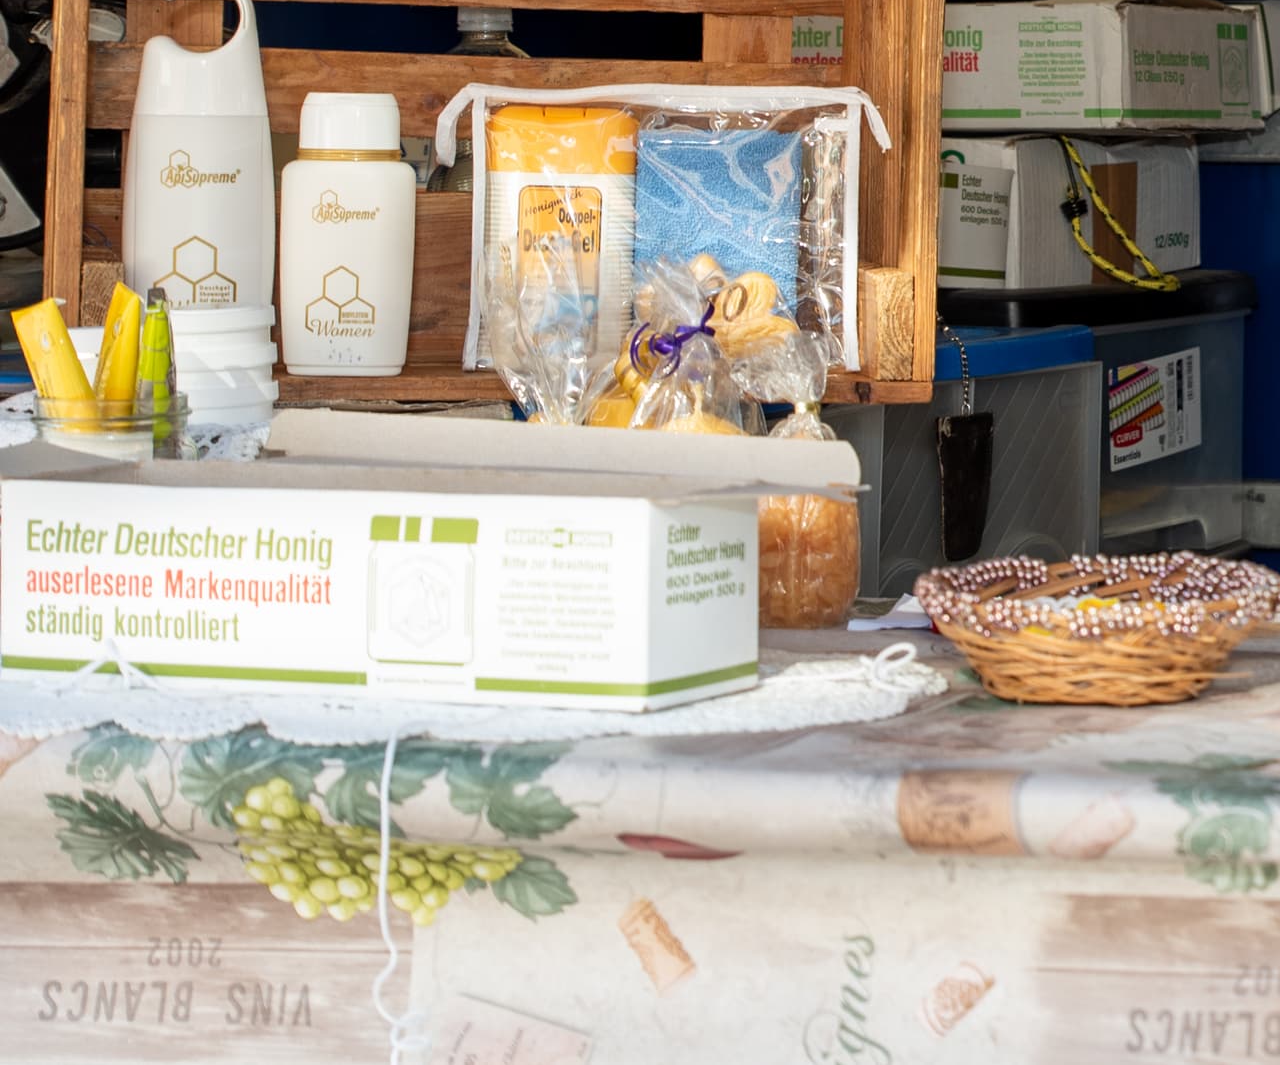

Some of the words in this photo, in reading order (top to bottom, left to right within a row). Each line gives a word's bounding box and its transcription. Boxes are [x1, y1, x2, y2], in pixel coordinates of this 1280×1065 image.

[944, 25, 982, 51] onig
[312, 319, 375, 338] Women
[27, 519, 108, 555] Echter
[114, 523, 248, 560] Deutscher
[255, 528, 334, 571] Honig
[26, 566, 154, 599] auserlesene
[164, 568, 332, 607] Markenqualität
[26, 604, 104, 642] ständig
[114, 606, 240, 643] kontrolliert
[146, 936, 223, 969] 2002
[37, 980, 193, 1025] BLANCS
[224, 982, 312, 1028] VINS
